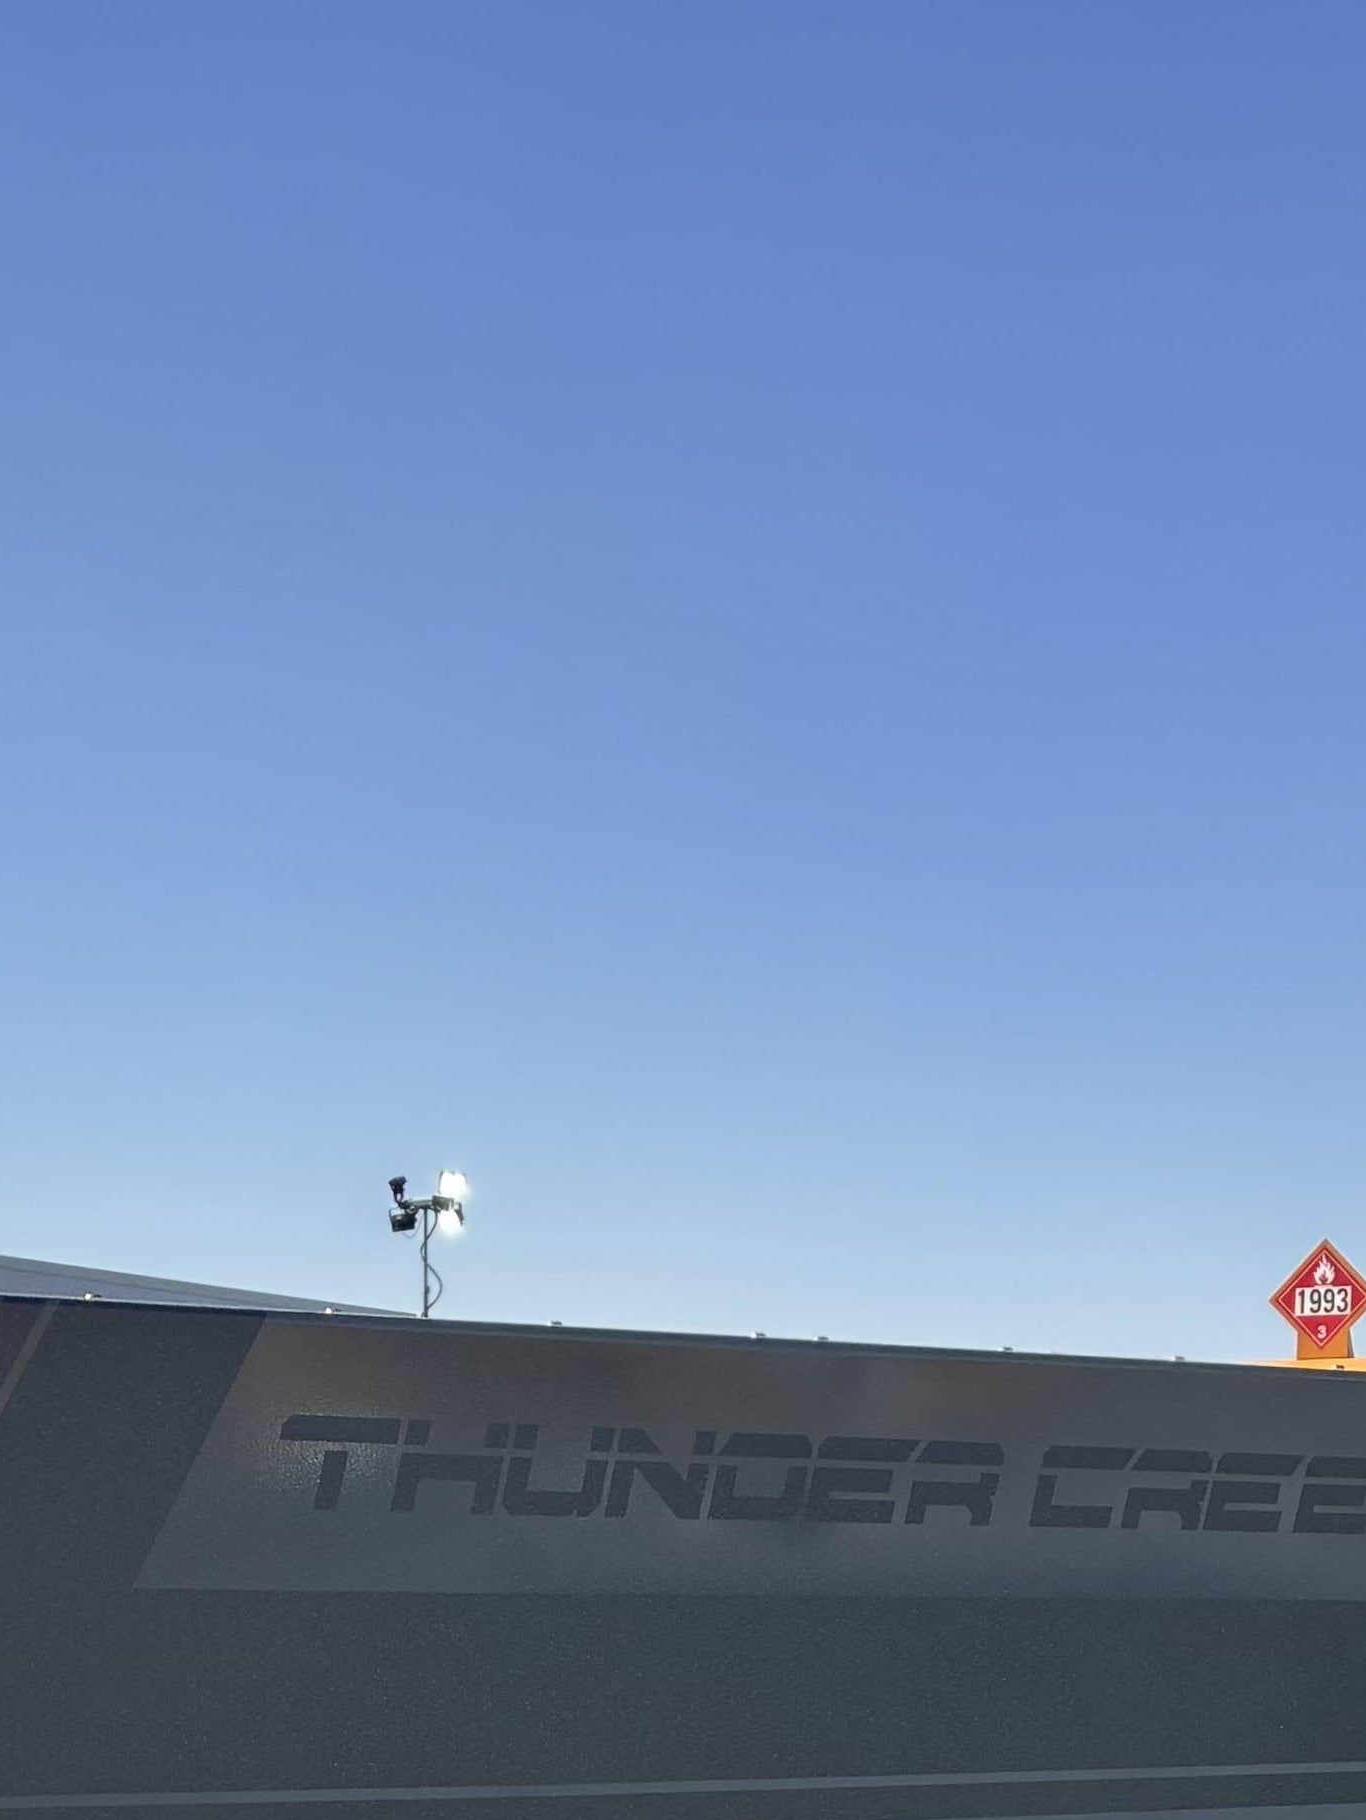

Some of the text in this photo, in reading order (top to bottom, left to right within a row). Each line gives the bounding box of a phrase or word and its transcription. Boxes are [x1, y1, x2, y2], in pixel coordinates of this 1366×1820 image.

[1298, 1288, 1348, 1314] 1993
[1317, 1325, 1327, 1339] 3
[280, 1414, 1004, 1527] THUNDER
